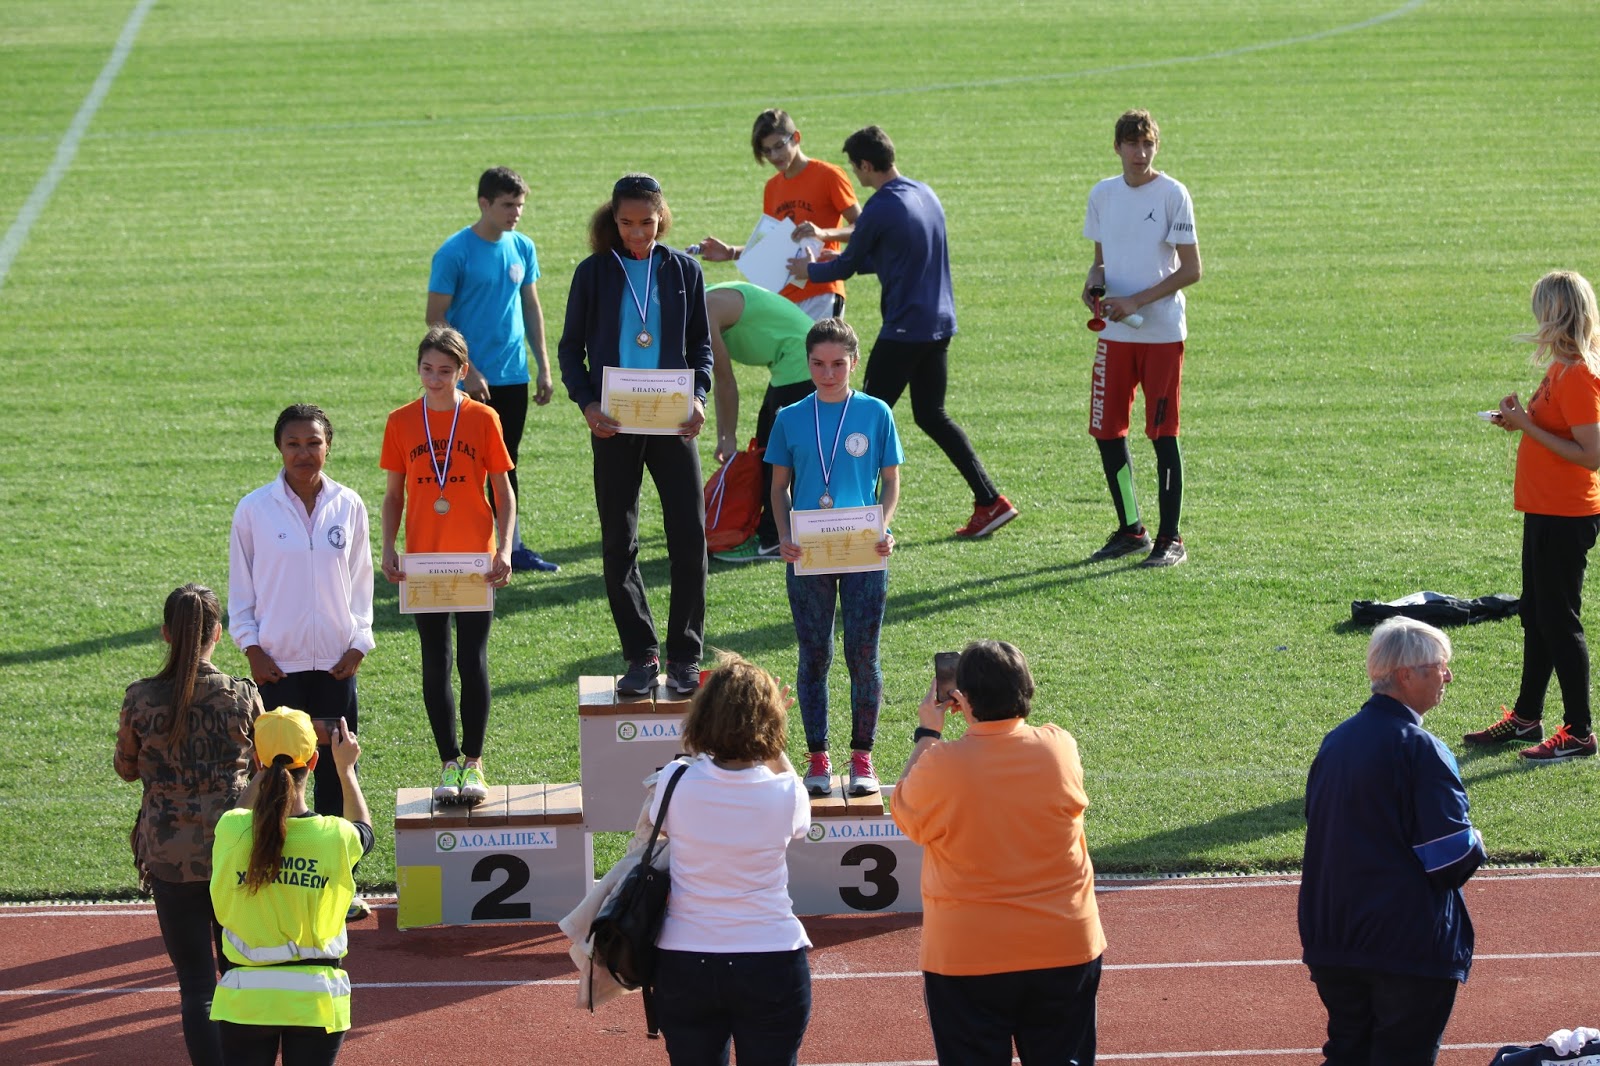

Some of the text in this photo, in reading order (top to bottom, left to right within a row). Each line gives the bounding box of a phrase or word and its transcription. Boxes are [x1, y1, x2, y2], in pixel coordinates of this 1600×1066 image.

[1092, 342, 1107, 430] PORTLAND
[417, 476, 466, 484] ΣΤΙΟΣ
[460, 832, 553, 847] Δ.Ο.Α.Π.ΠΕ.Χ.
[236, 871, 329, 889] ΧΚΙΔΕΩΝ
[471, 854, 531, 920] 2
[839, 843, 899, 911] 3
